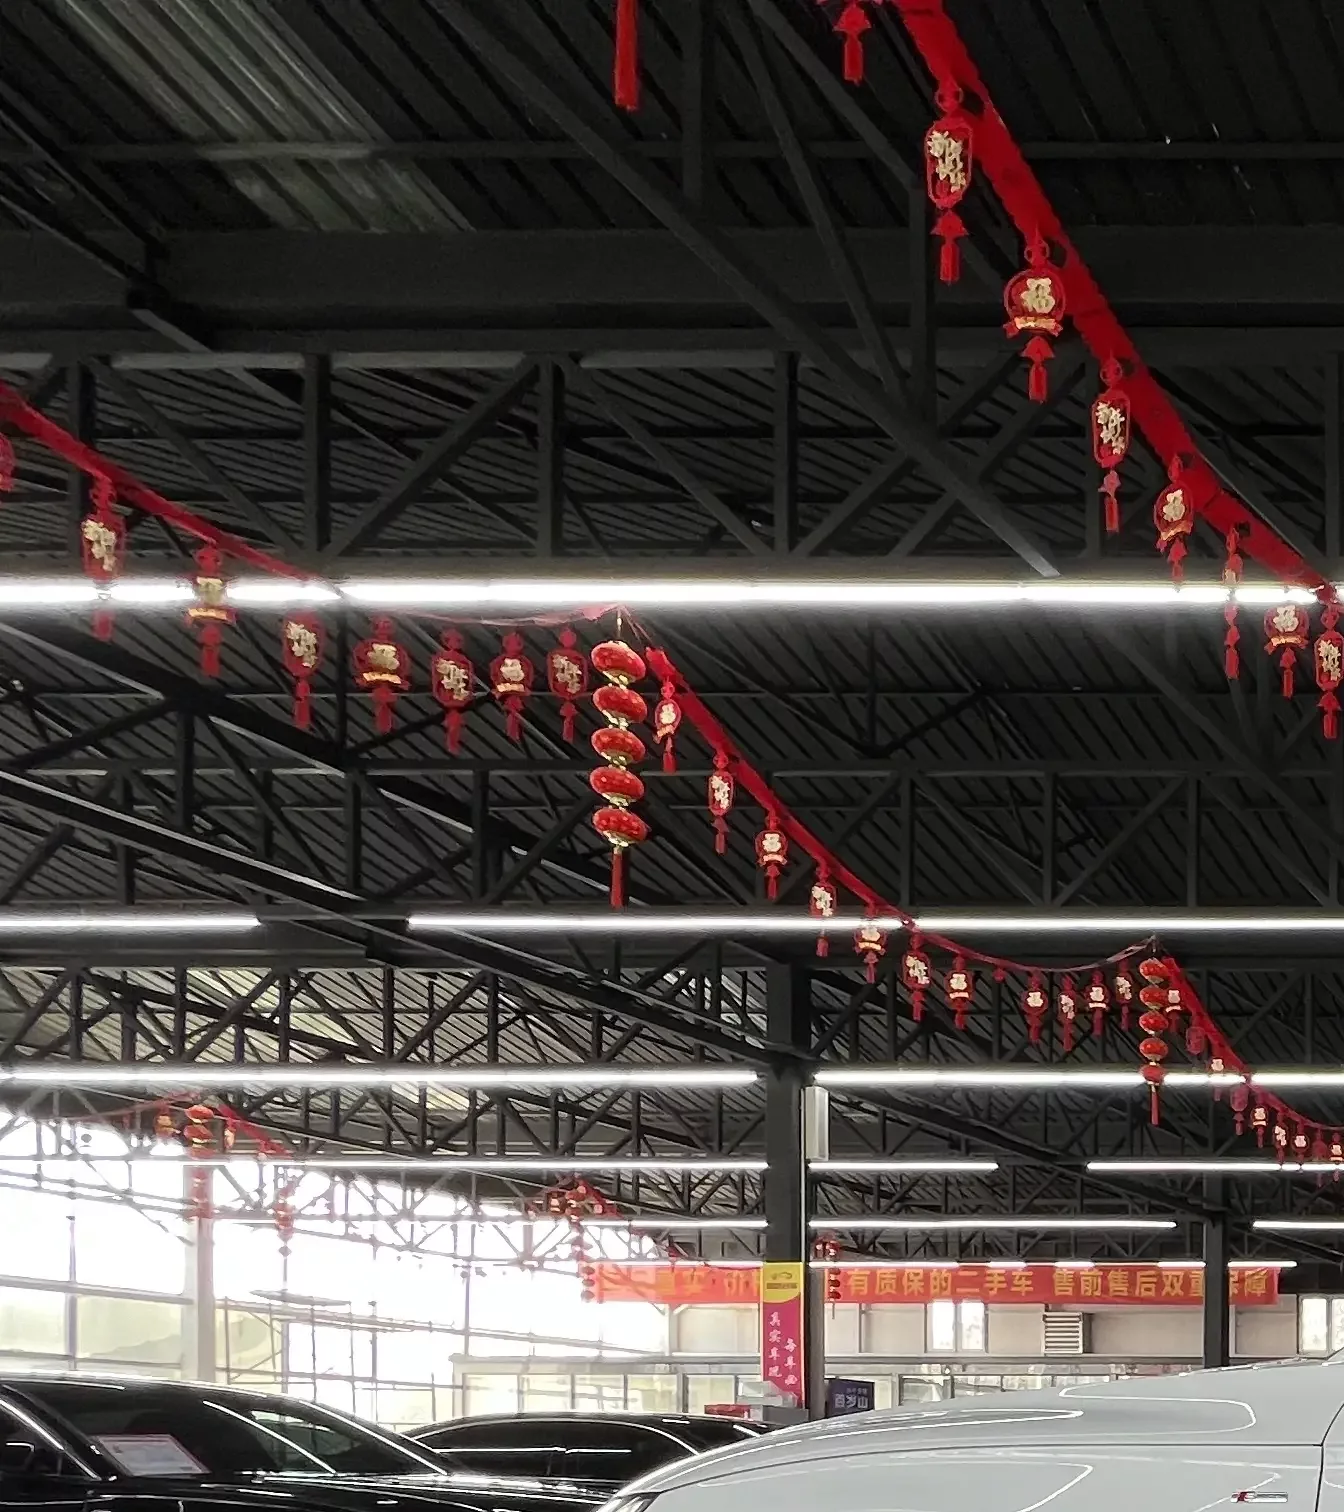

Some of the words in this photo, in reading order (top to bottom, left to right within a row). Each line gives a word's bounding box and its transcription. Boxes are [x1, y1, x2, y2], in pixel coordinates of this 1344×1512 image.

[847, 1268, 1034, 1296] 有质保的二手车
